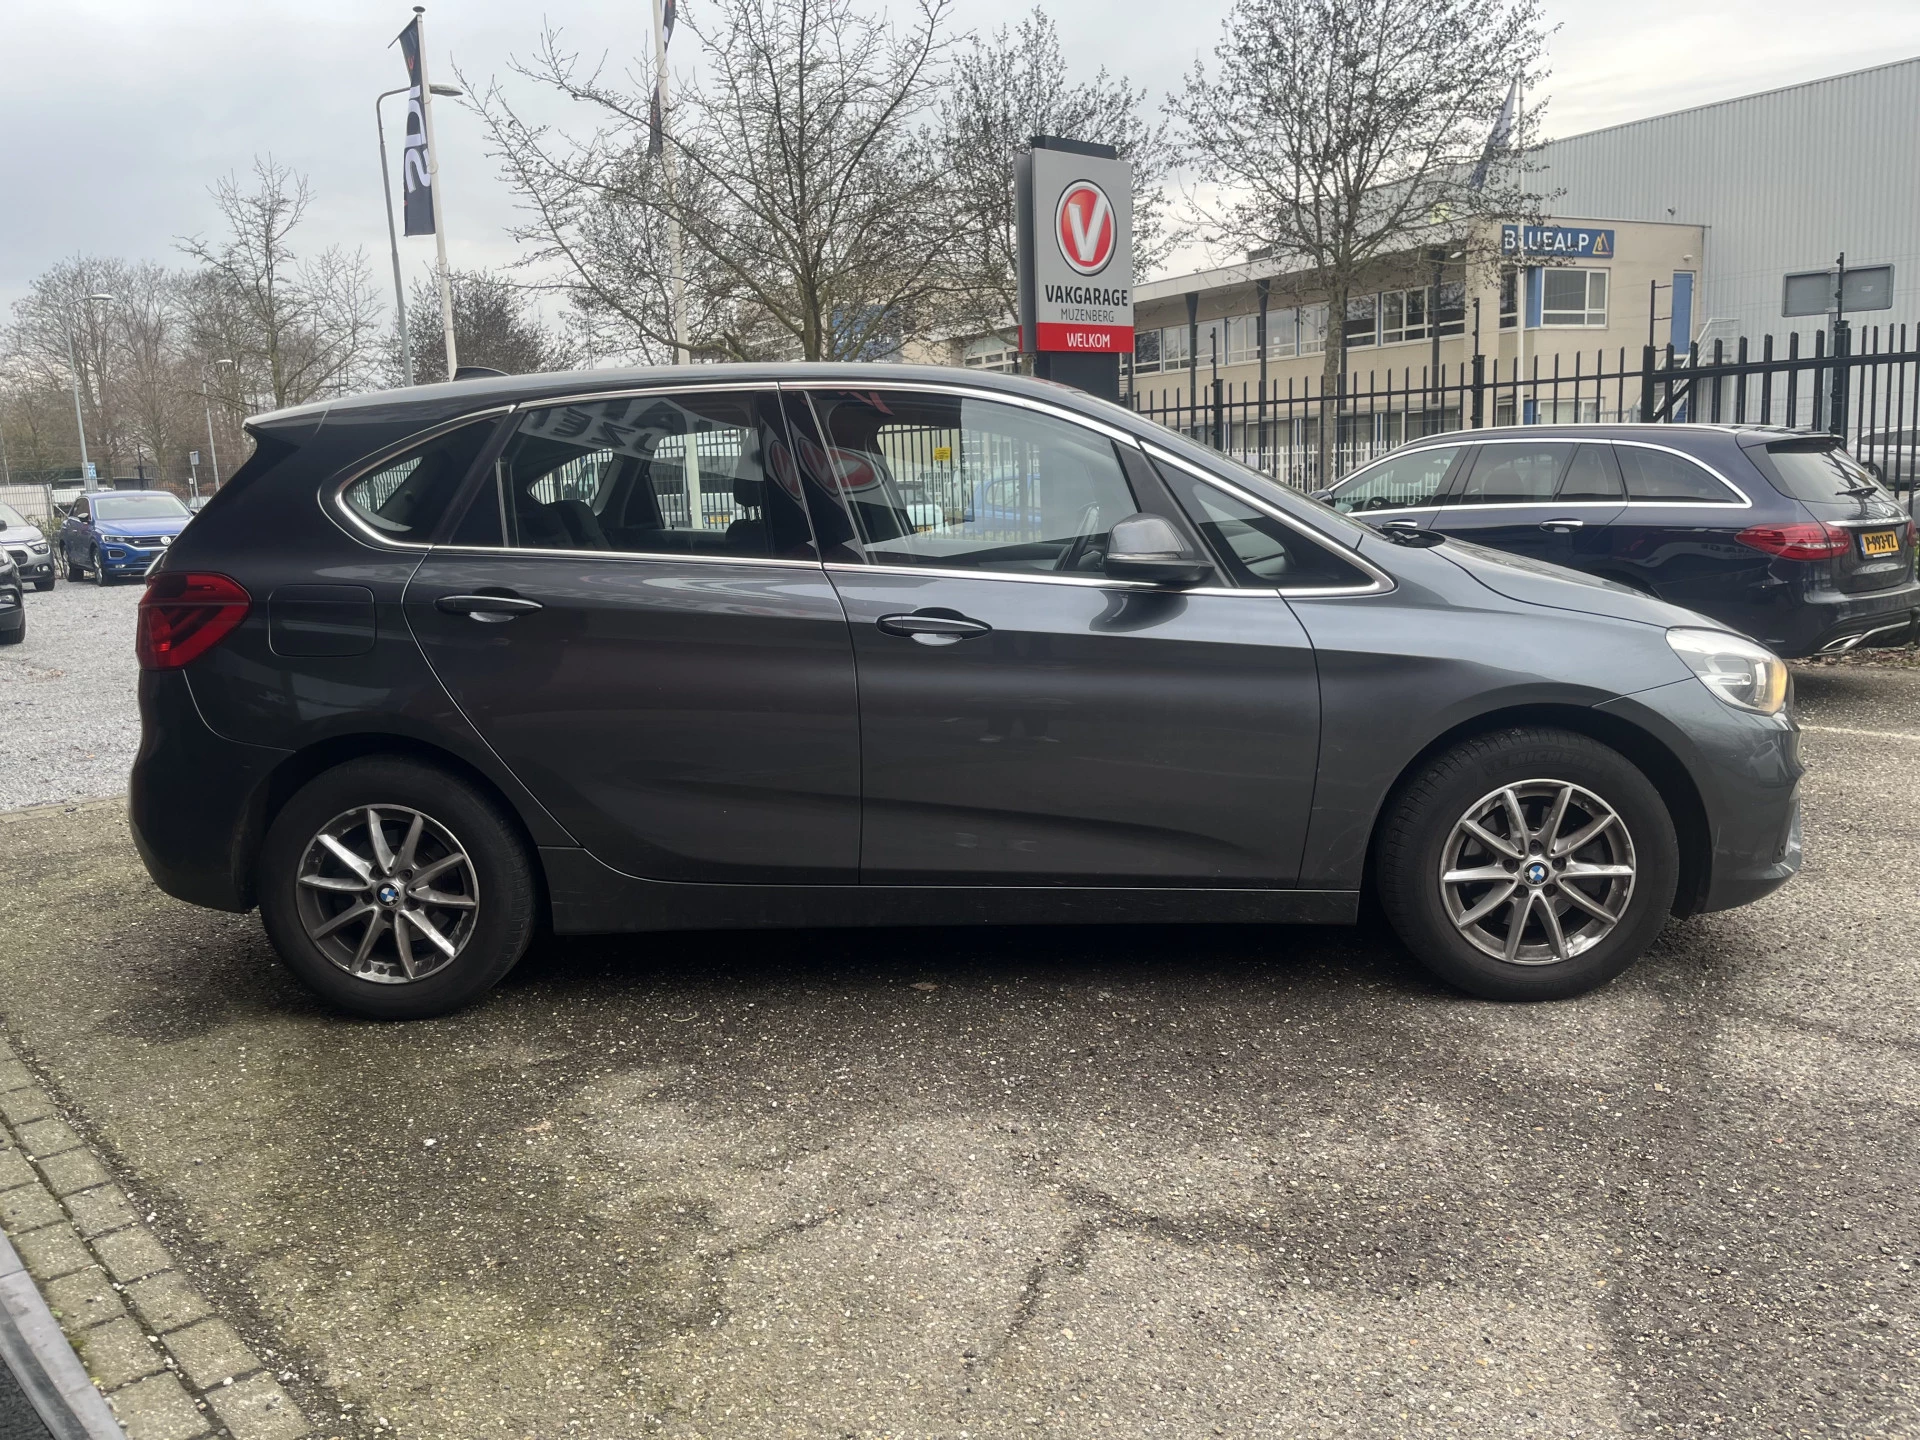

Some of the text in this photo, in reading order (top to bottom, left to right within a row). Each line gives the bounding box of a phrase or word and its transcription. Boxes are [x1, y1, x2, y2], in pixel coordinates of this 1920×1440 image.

[1504, 230, 1590, 252] BUEALP
[1045, 285, 1128, 306] VAKGARAGE
[1061, 308, 1115, 322] MUZENBERG
[1067, 333, 1110, 348] WELKOM
